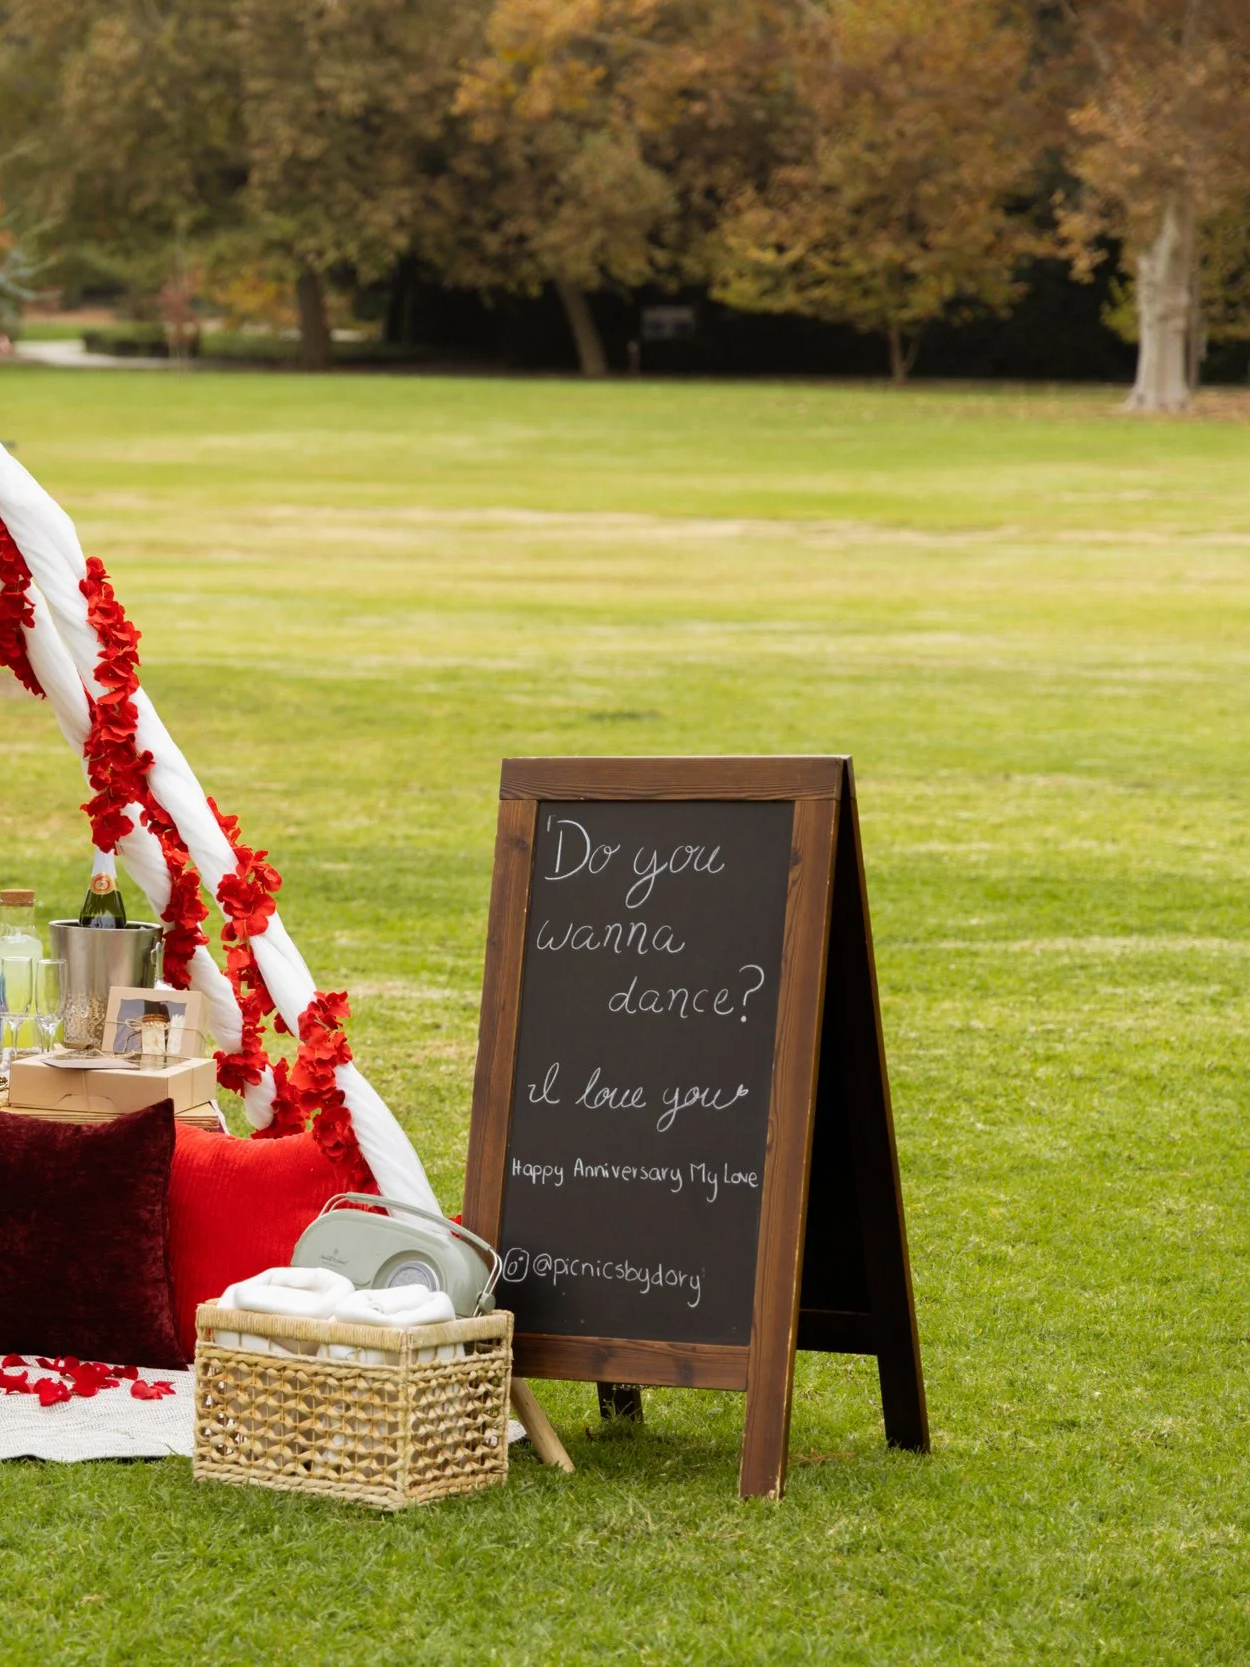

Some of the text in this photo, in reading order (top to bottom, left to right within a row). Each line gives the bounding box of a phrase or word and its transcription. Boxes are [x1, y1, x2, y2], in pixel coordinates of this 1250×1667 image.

[545, 816, 725, 909] Do you
[535, 919, 686, 955] wanna
[608, 964, 765, 1023] dance?
[527, 1062, 749, 1133] I love you
[512, 1157, 759, 1203] Happy Anniversary My Love
[532, 1253, 701, 1308] @picnicsbydory
